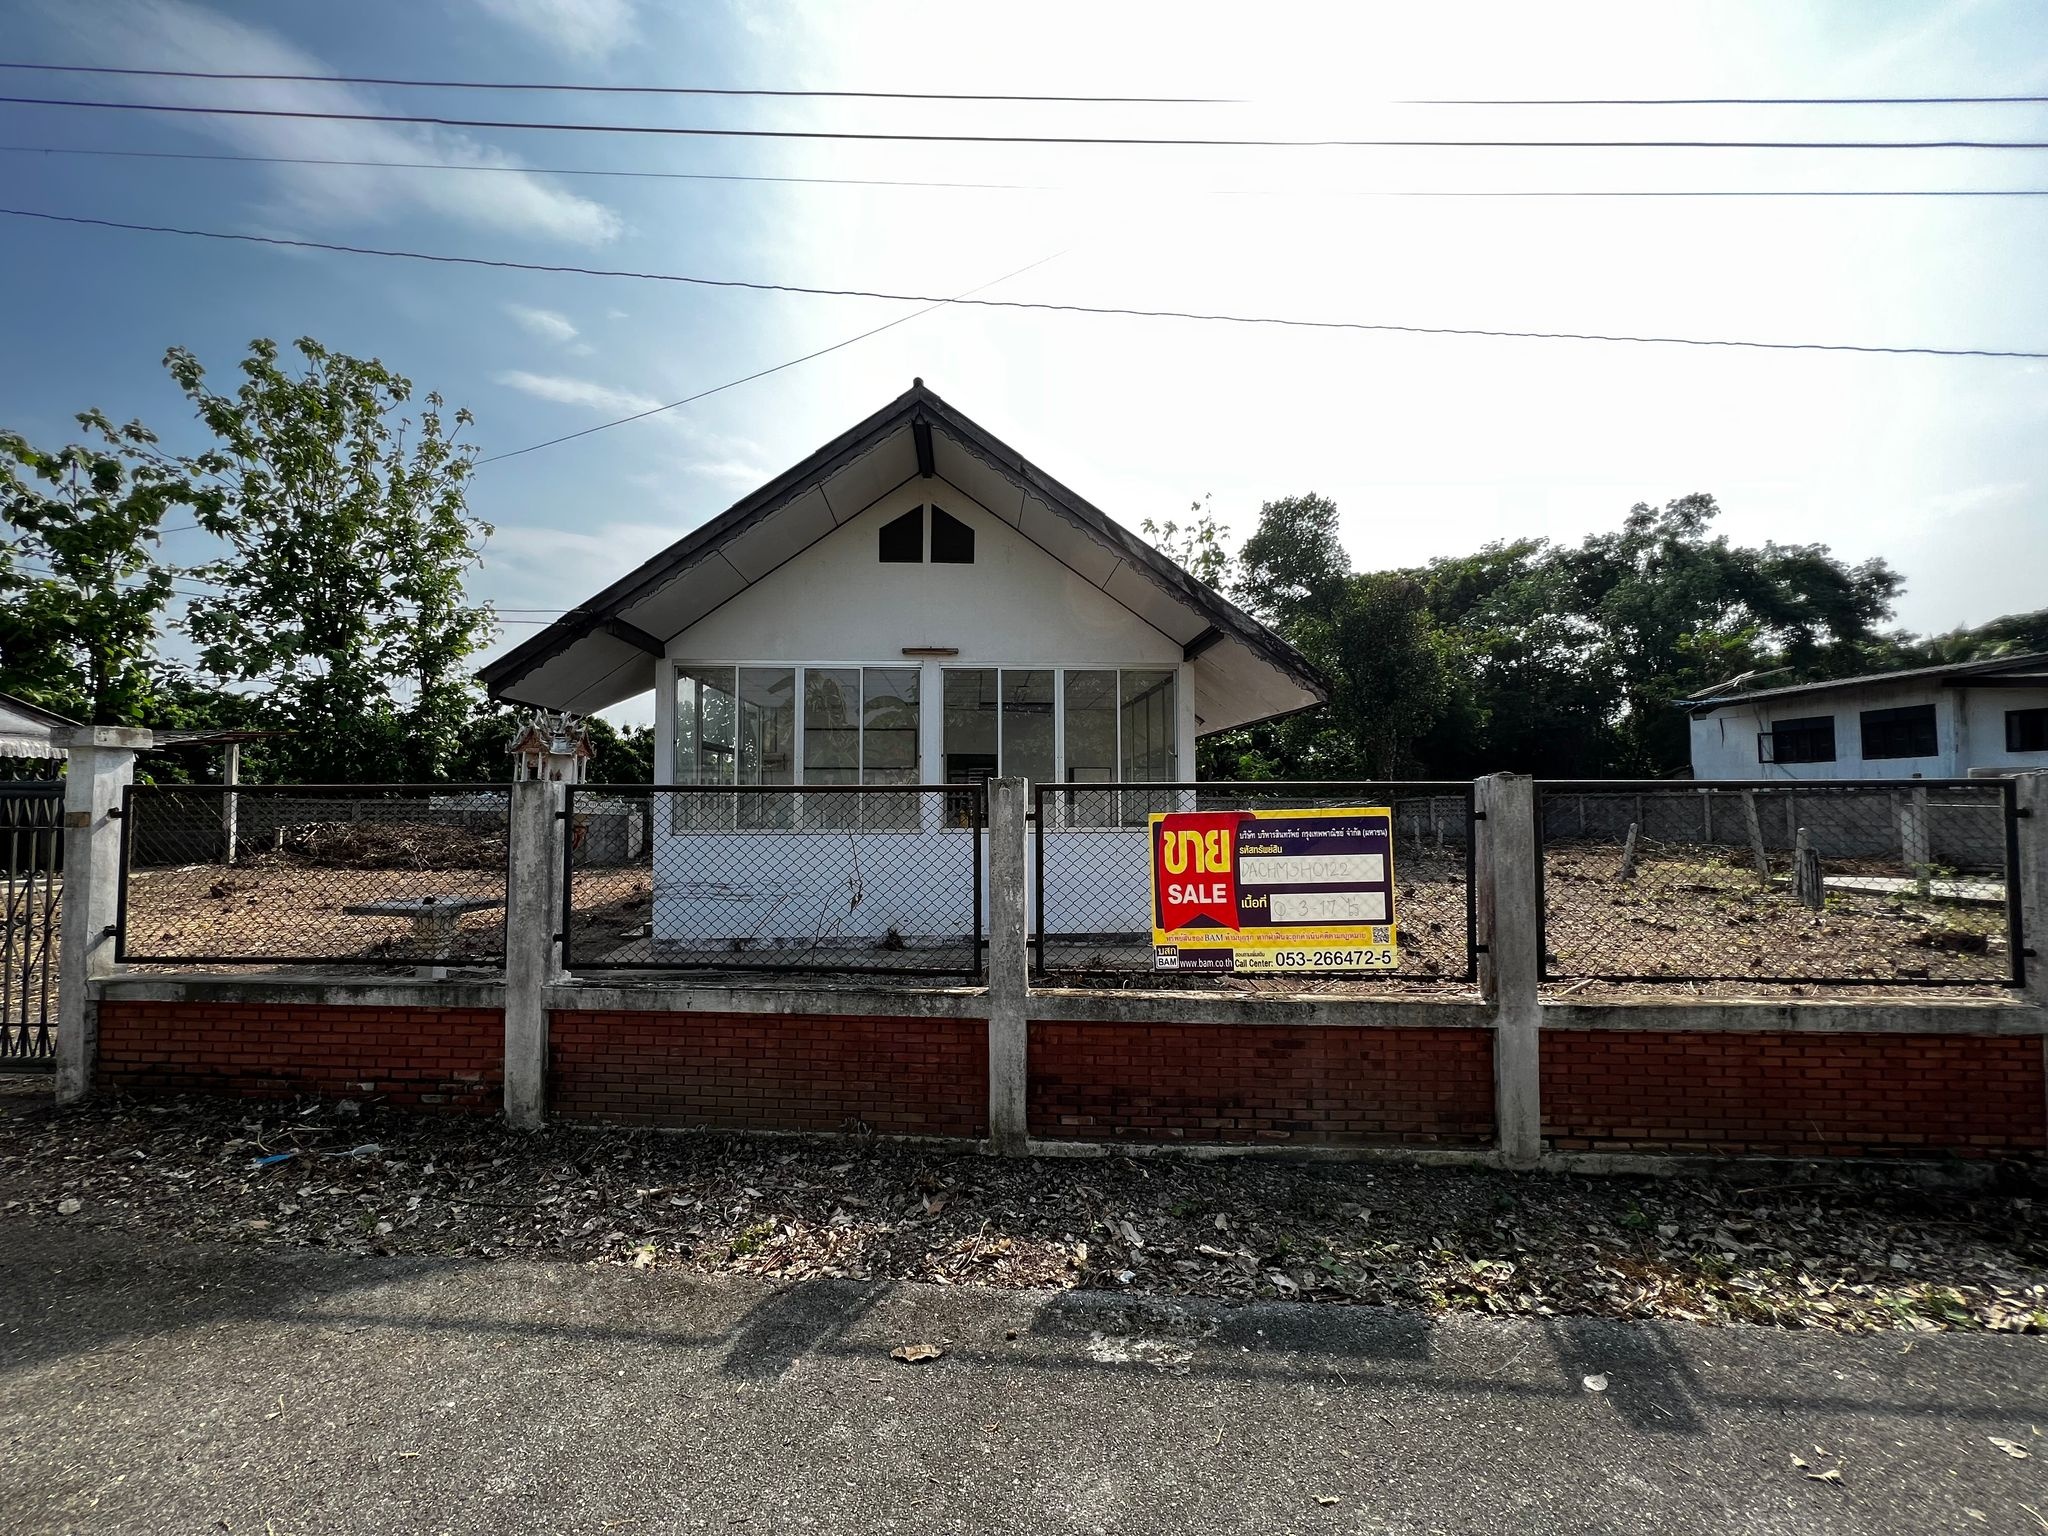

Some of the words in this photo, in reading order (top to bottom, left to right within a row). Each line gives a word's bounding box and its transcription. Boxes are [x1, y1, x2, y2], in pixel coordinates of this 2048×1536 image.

[1239, 829, 1256, 840] บริษัท
[1345, 827, 1361, 837] จำกัด
[1362, 828, 1388, 838] (มหาชน)
[1163, 829, 1231, 874] ขาย
[1239, 844, 1283, 855] รหัสทรัพย์สิน
[1167, 883, 1227, 905] SALE
[1241, 894, 1268, 909] เนื้อที่
[1204, 934, 1223, 942] BAM
[1158, 957, 1177, 967] BAM
[1179, 957, 1233, 969] www.bam.co.th
[1234, 958, 1248, 968] Call
[1249, 958, 1274, 968] Center:
[1275, 950, 1392, 967] 053-266472-5
